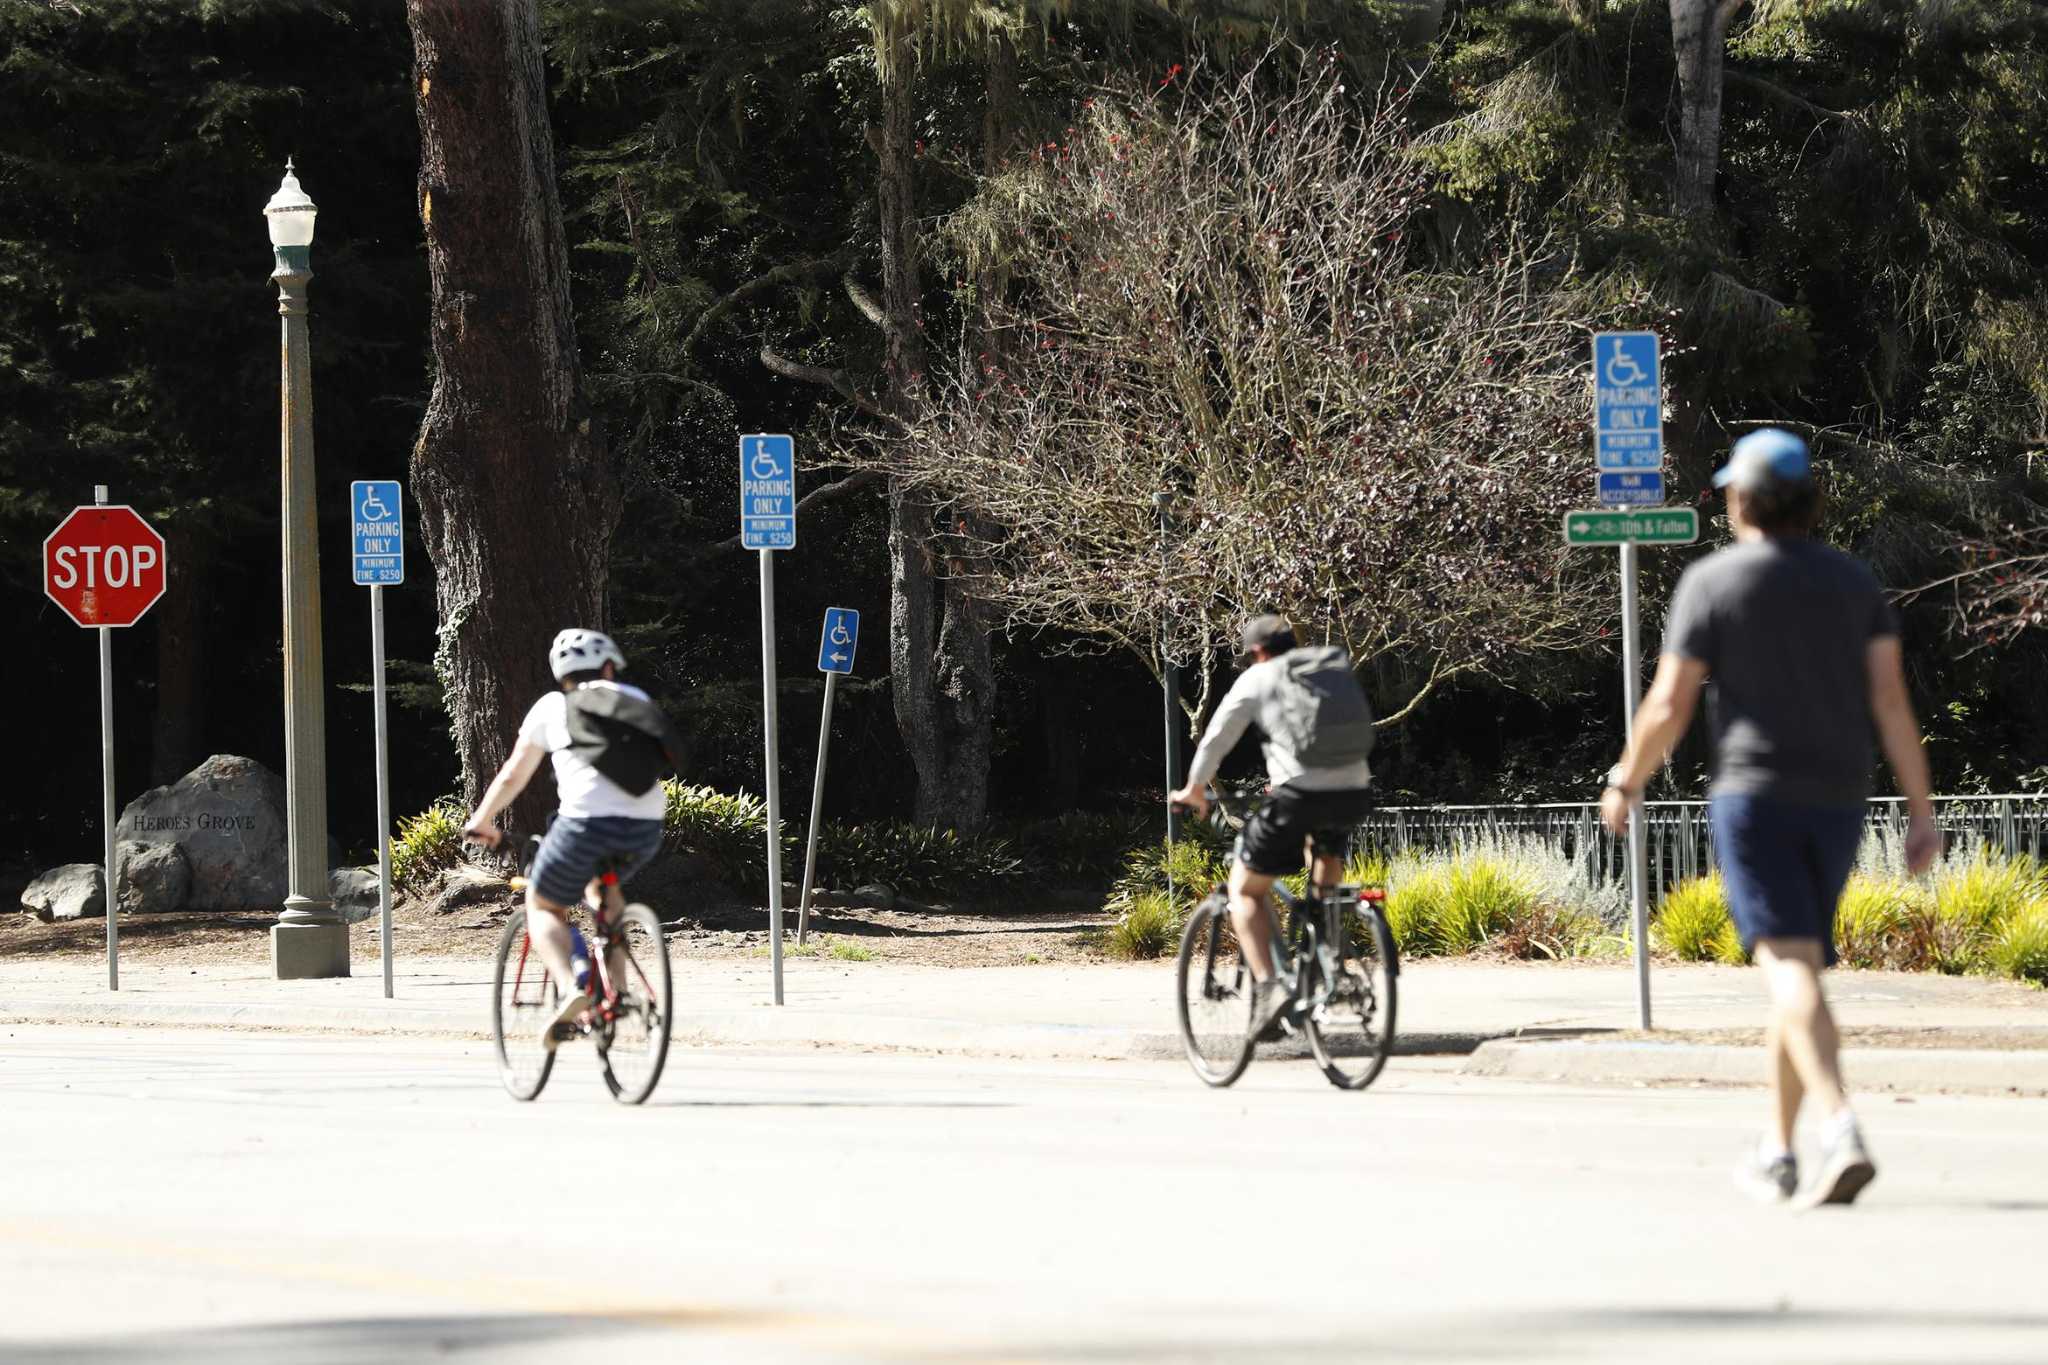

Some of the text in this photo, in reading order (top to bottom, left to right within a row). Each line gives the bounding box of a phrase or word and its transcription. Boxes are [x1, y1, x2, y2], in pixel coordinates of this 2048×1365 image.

[1610, 408, 1647, 429] ONLY
[744, 480, 791, 497] PARKING
[753, 498, 782, 514] ONLY
[356, 521, 399, 537] PARKING
[751, 519, 786, 531] MINIMUM
[364, 538, 391, 553] ONLY
[745, 532, 792, 545] FINE $250
[53, 544, 157, 589] STOP
[361, 558, 395, 569] MINIMUM
[357, 569, 400, 580] FINE $250
[133, 813, 256, 831] HEROES GROVE
